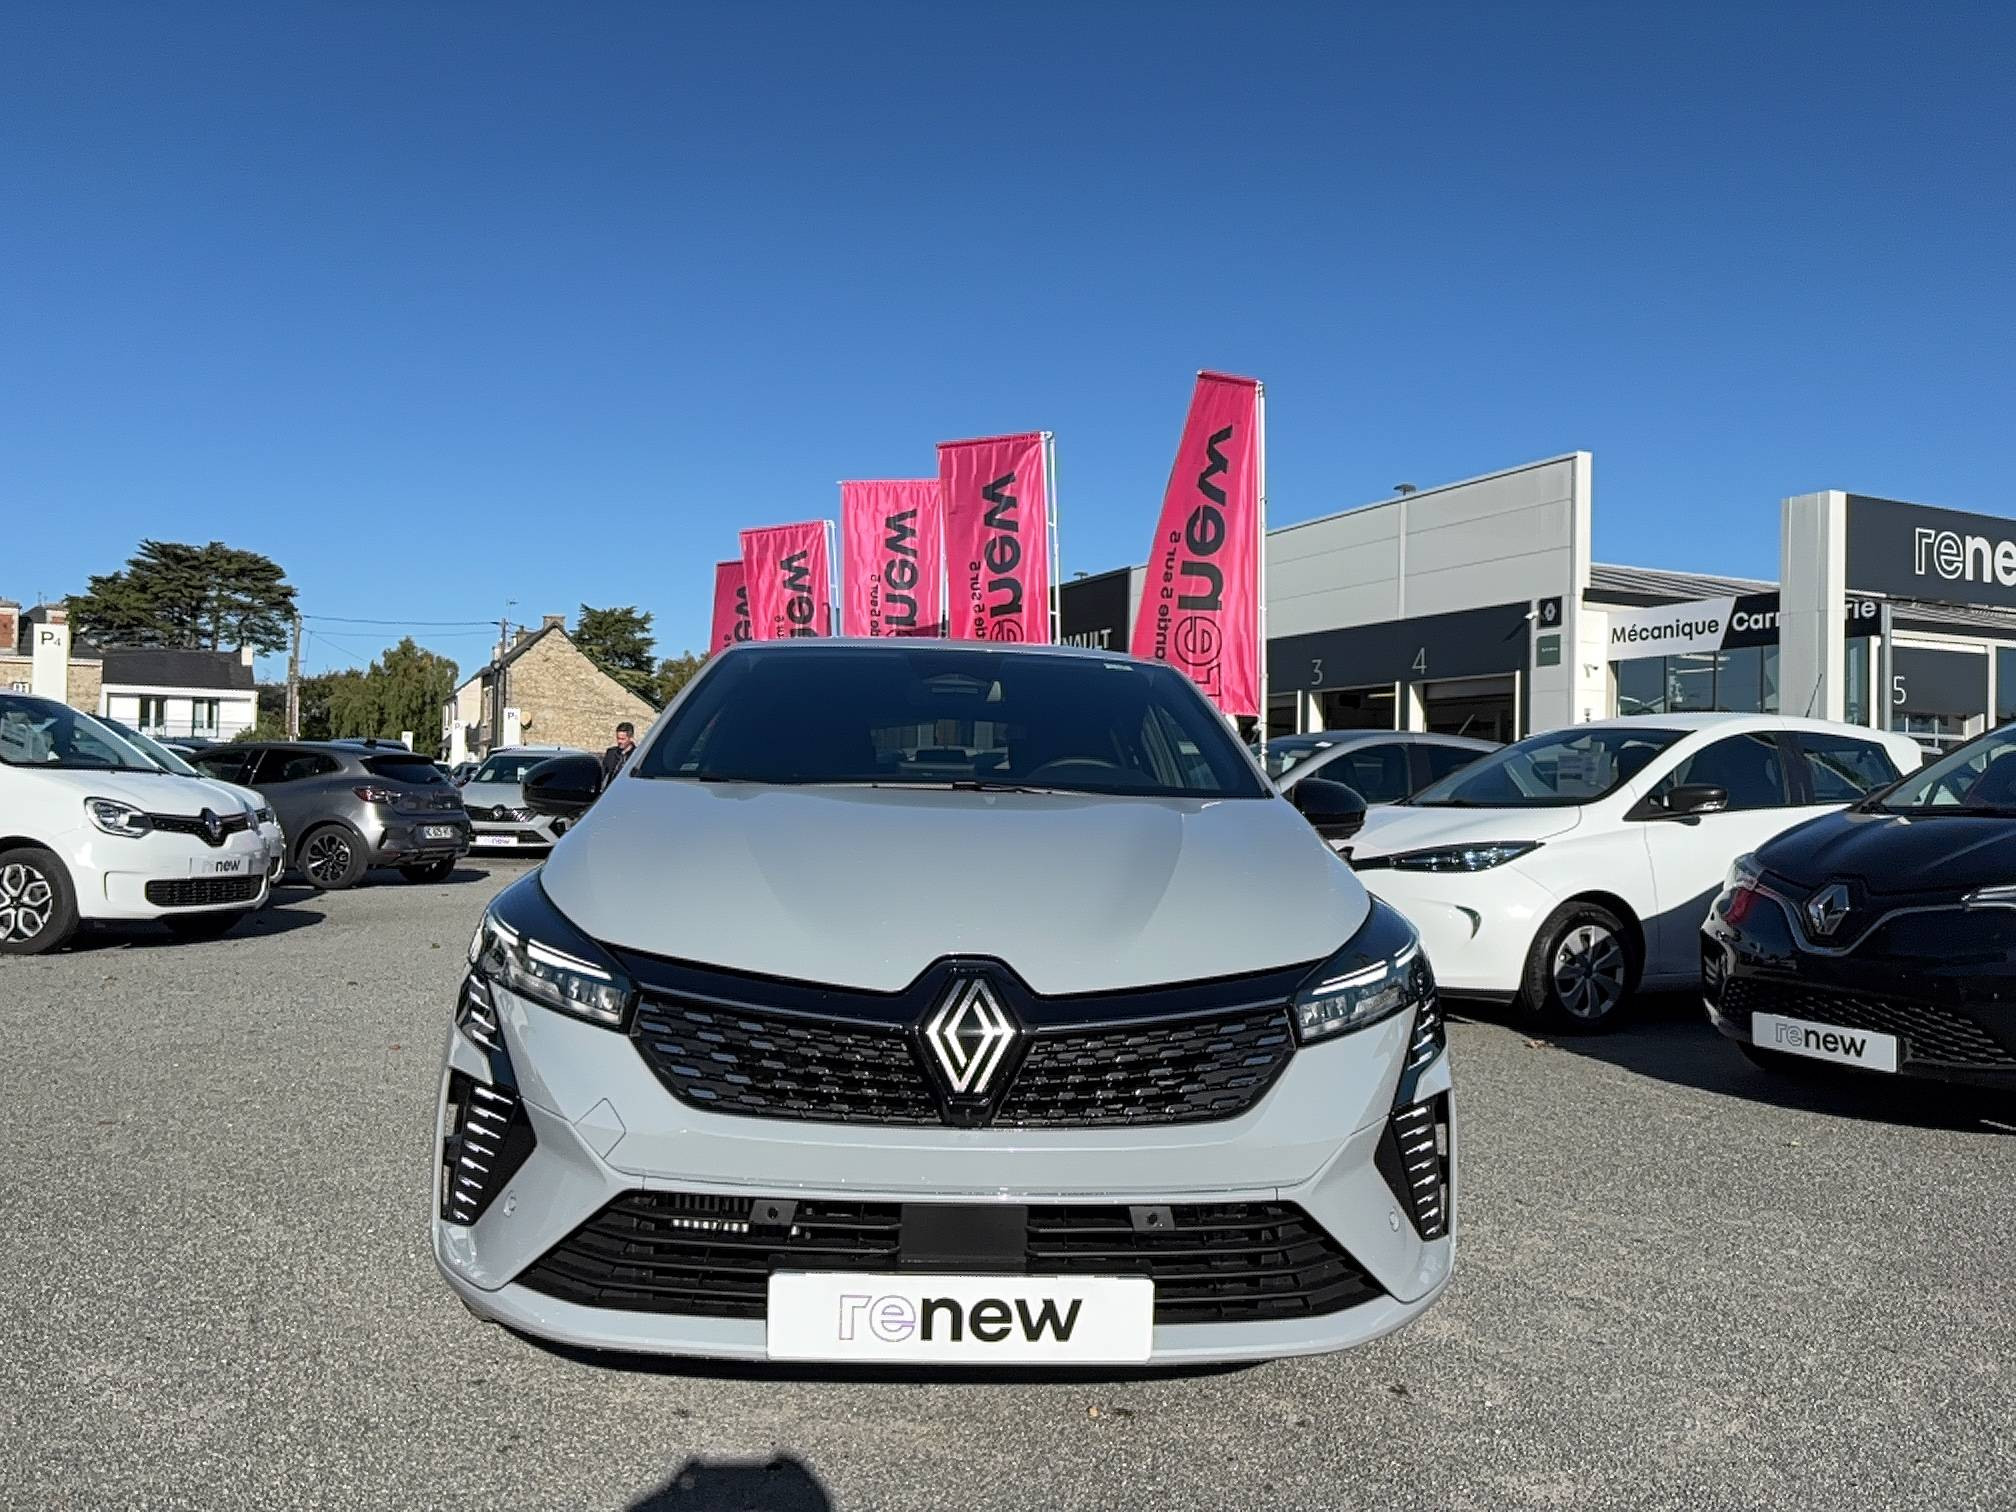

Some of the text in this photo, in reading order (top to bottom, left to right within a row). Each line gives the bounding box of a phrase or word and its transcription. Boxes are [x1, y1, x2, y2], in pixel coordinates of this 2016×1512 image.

[1915, 527, 2016, 587] rene
[1611, 618, 1720, 644] Mécanique
[1311, 659, 1323, 685] 3
[1412, 647, 1427, 675] 4
[1893, 675, 1907, 704] 5
[1775, 1022, 1866, 1058] renew
[838, 1294, 1083, 1343] renew
